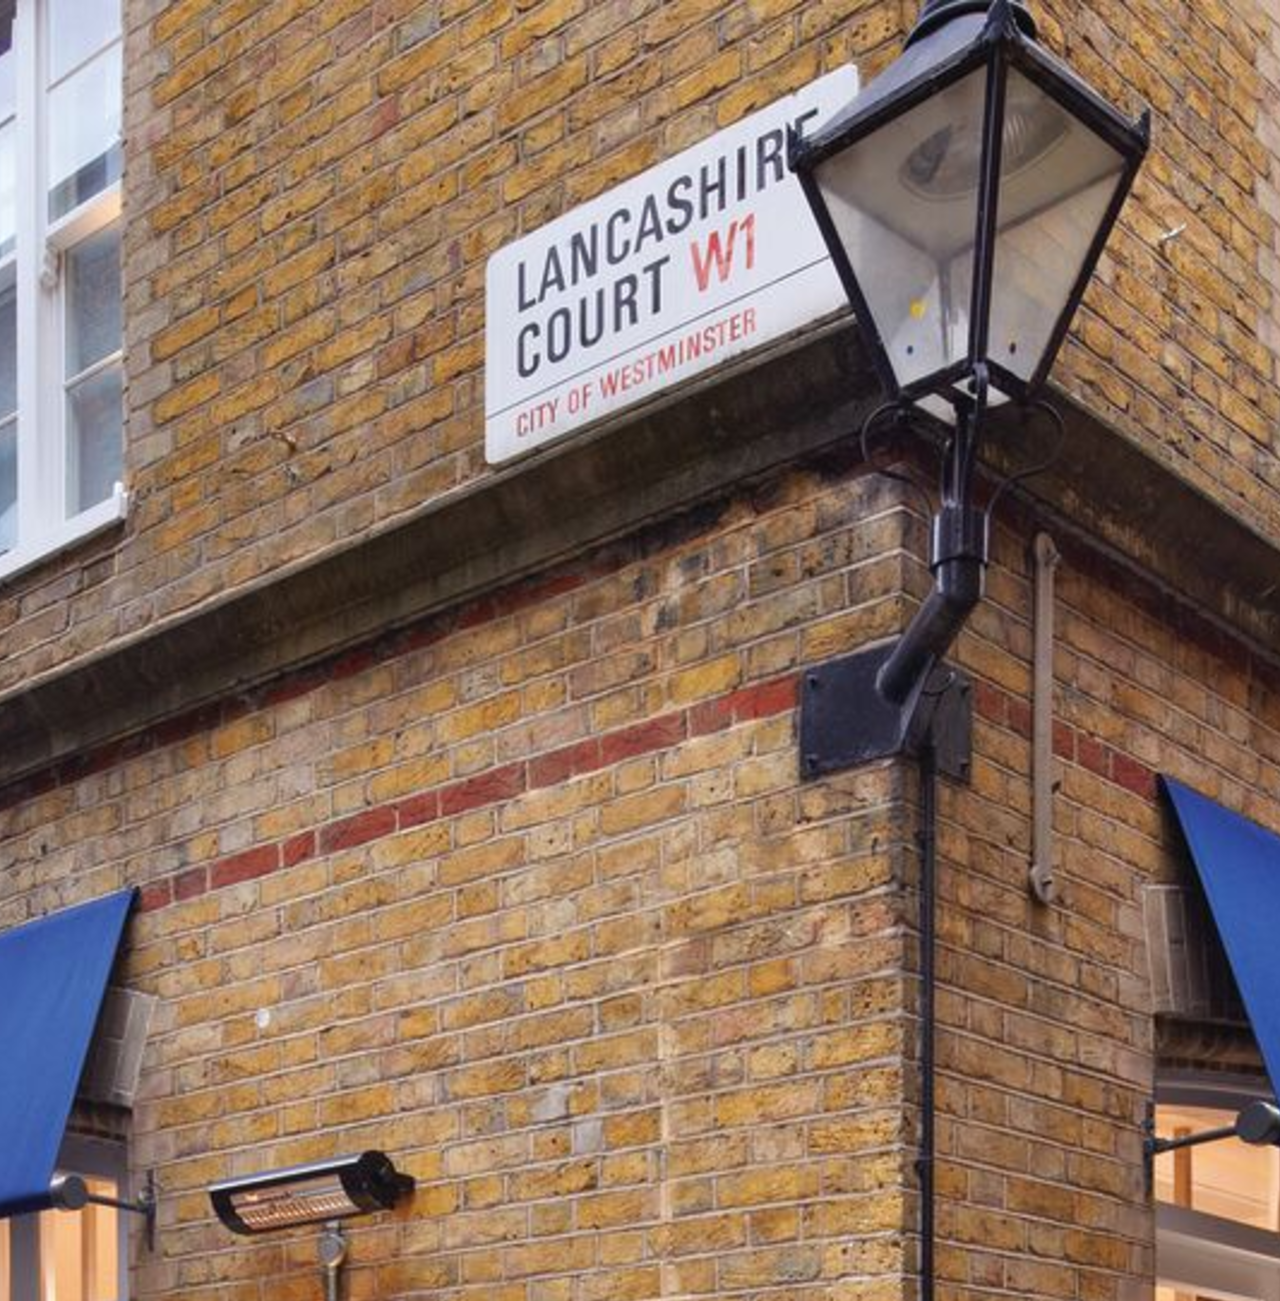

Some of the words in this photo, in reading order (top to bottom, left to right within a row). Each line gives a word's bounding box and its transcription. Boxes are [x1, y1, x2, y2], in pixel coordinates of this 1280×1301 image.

[517, 256, 671, 378] COURT
[690, 213, 756, 292] W1
[516, 399, 559, 438] CITY
[567, 382, 594, 414] OF
[600, 307, 757, 399] WESTMINSTER
